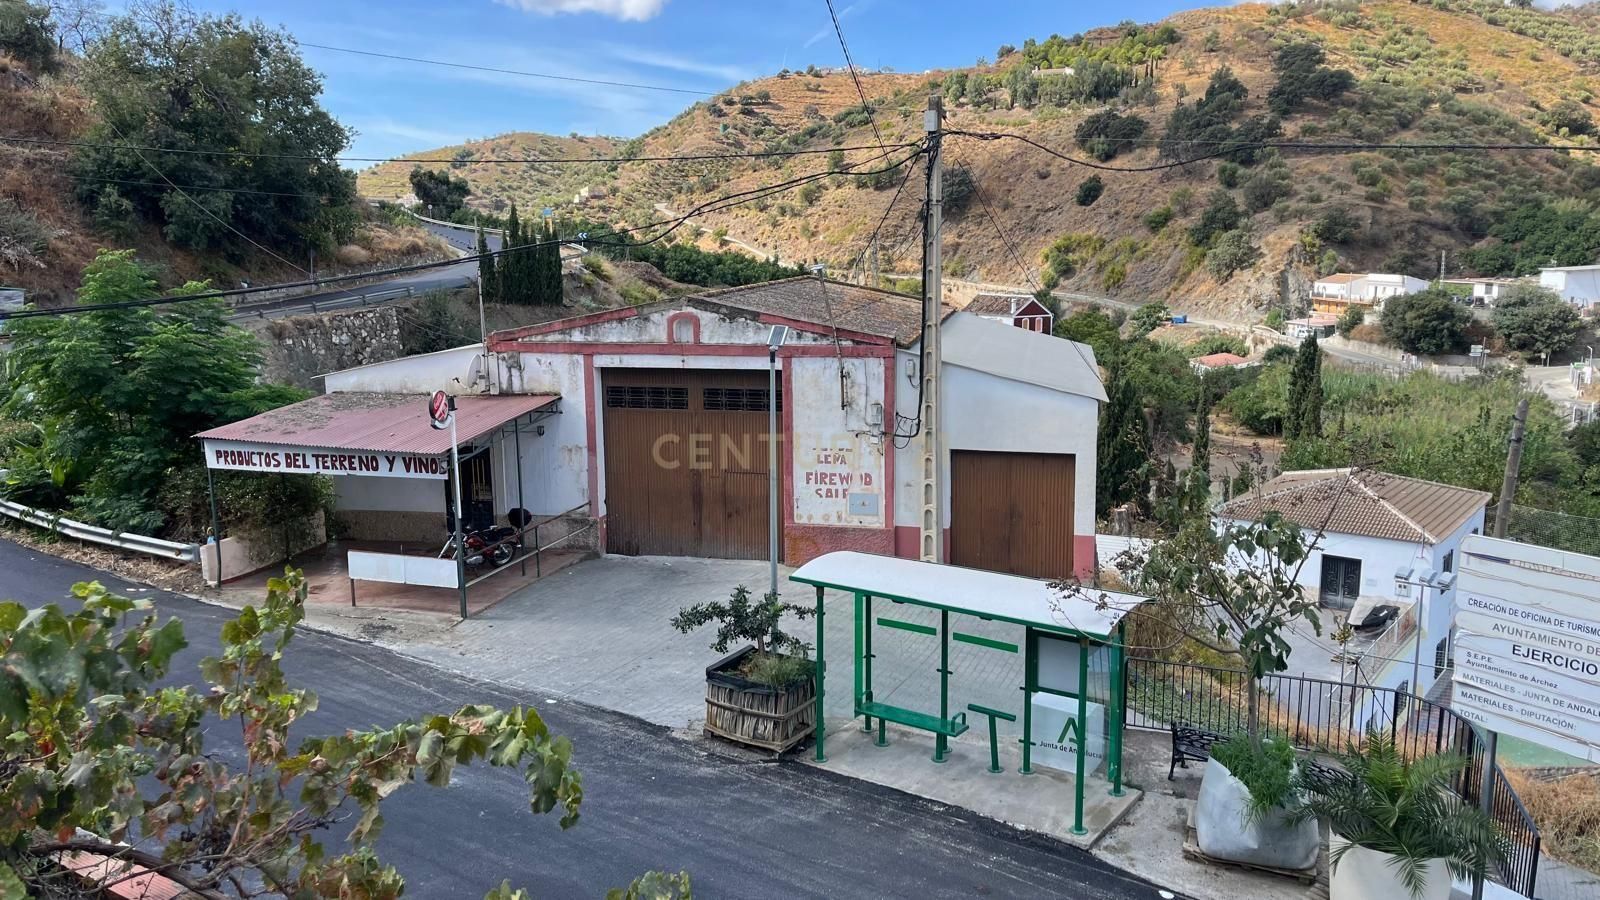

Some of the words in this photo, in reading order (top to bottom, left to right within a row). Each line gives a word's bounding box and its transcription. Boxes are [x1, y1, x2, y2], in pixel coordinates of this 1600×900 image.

[215, 449, 281, 468] PRODUCTOS
[285, 452, 310, 469] DEL
[312, 454, 379, 472] TERRENO
[385, 456, 397, 473] Y
[1468, 597, 1507, 614] CREACIÓN
[1508, 607, 1519, 617] DE
[1520, 611, 1552, 625] OFICINA
[1553, 618, 1564, 628] DE
[1492, 623, 1583, 652] AYUNTAMIENTO
[1586, 645, 1600, 657] DE
[1466, 659, 1517, 678] Ayuntamiento
[1519, 673, 1529, 681] de
[1512, 644, 1598, 676] EJERCICIO
[1461, 691, 1514, 712] MATERIALES
[1521, 708, 1576, 731] DIPUTACIÓN:
[1462, 673, 1515, 692] MATERIALES
[1523, 690, 1551, 704] JUNTA
[1553, 698, 1565, 708] DE
[1567, 702, 1600, 718] ANDAL
[1459, 709, 1488, 723] TOTAL:
[1040, 741, 1058, 750] Junta
